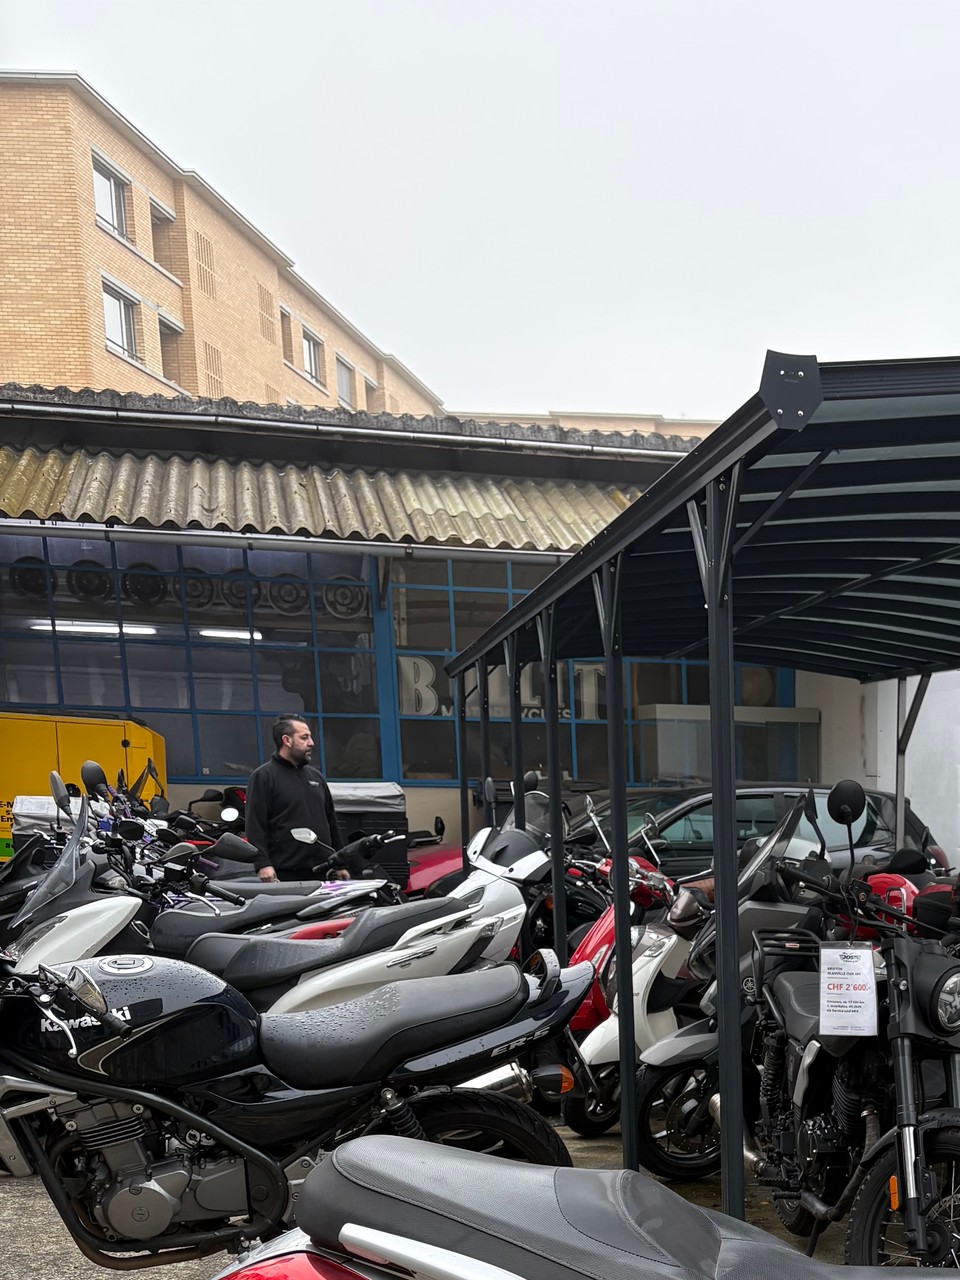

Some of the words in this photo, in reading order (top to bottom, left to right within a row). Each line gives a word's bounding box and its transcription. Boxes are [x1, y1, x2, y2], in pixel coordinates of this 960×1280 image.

[827, 983, 843, 991] CHF
[41, 1006, 132, 1032] Kawaski
[490, 1026, 551, 1057] ER-5
